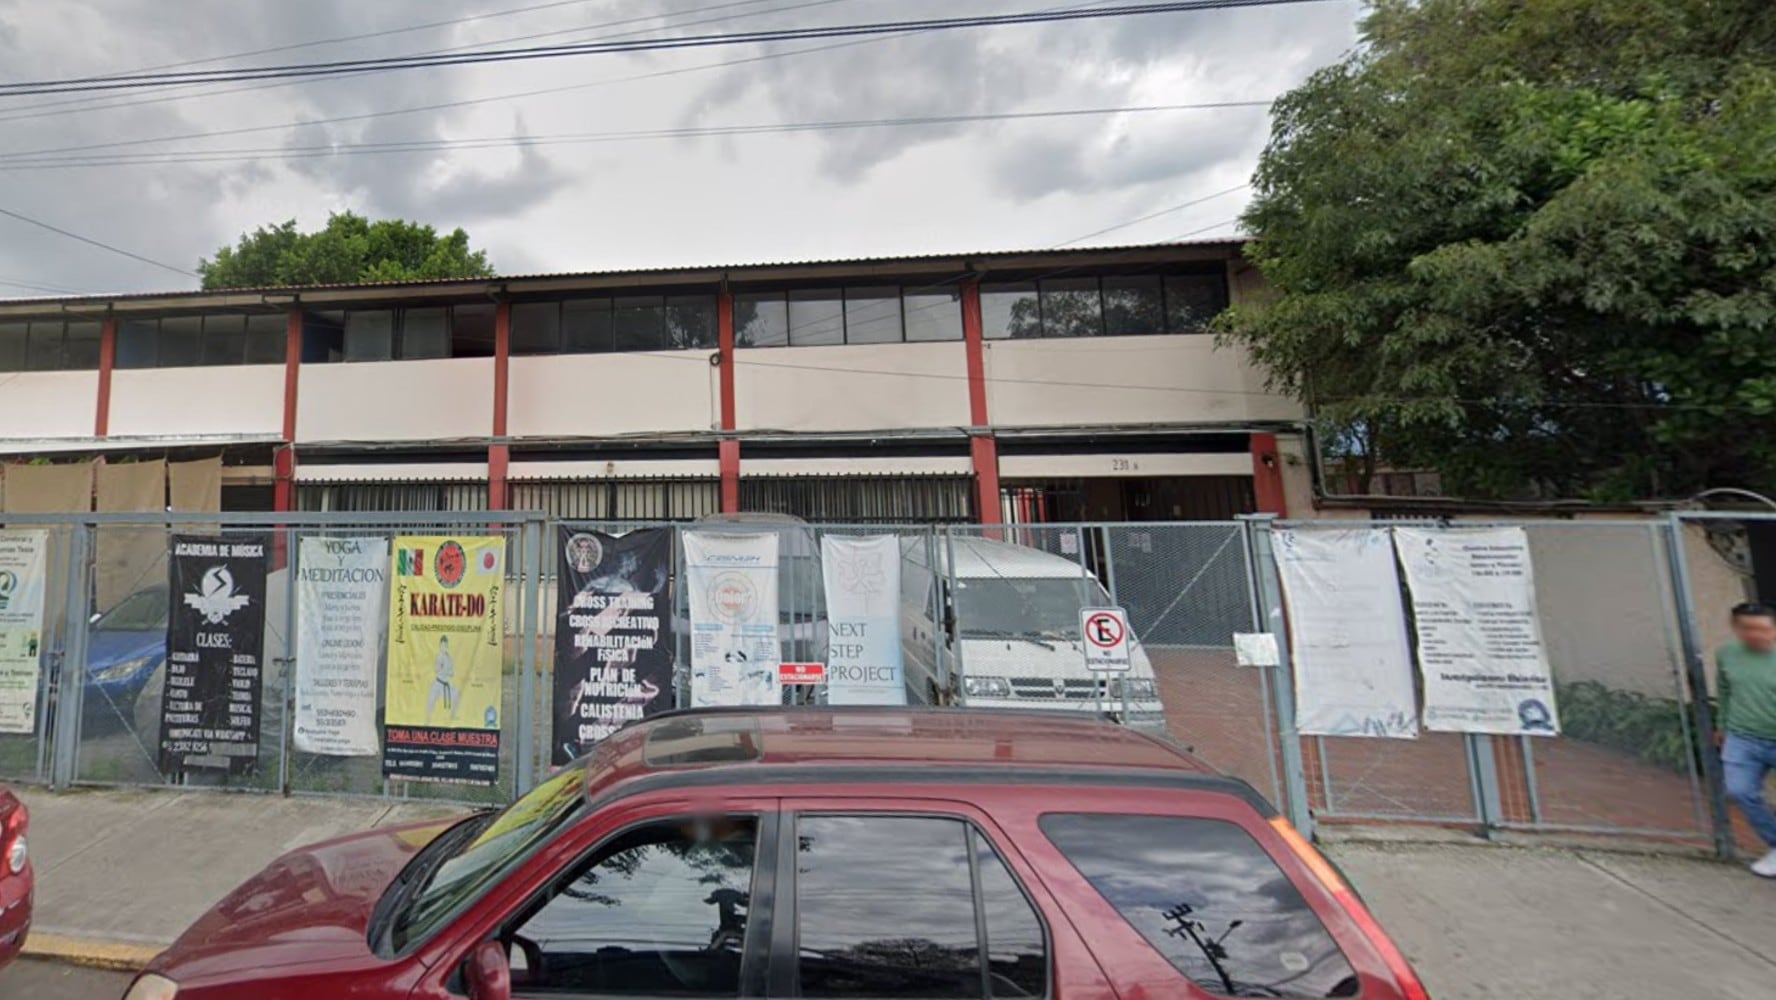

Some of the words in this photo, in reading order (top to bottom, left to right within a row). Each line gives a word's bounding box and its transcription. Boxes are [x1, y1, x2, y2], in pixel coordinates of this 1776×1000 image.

[175, 543, 217, 556] ACADEMIA
[219, 545, 229, 557] DE
[325, 540, 362, 554] YOGA
[337, 555, 345, 567] Y
[301, 567, 384, 582] MEDITACION
[410, 592, 485, 617] KARATE-DO
[829, 622, 868, 638] NEXT
[1096, 618, 1112, 642] E
[196, 632, 232, 648] CLASES:
[830, 643, 864, 659] STEP
[589, 667, 618, 682] PLAN
[621, 668, 637, 682] DE
[795, 665, 807, 673] NO
[830, 665, 897, 683] PROJECT
[580, 703, 644, 719] CALISTENIA
[387, 729, 411, 741] TOMA
[411, 730, 429, 742] UNA
[430, 731, 457, 743] CLASE
[458, 733, 498, 746] MUESTRA
